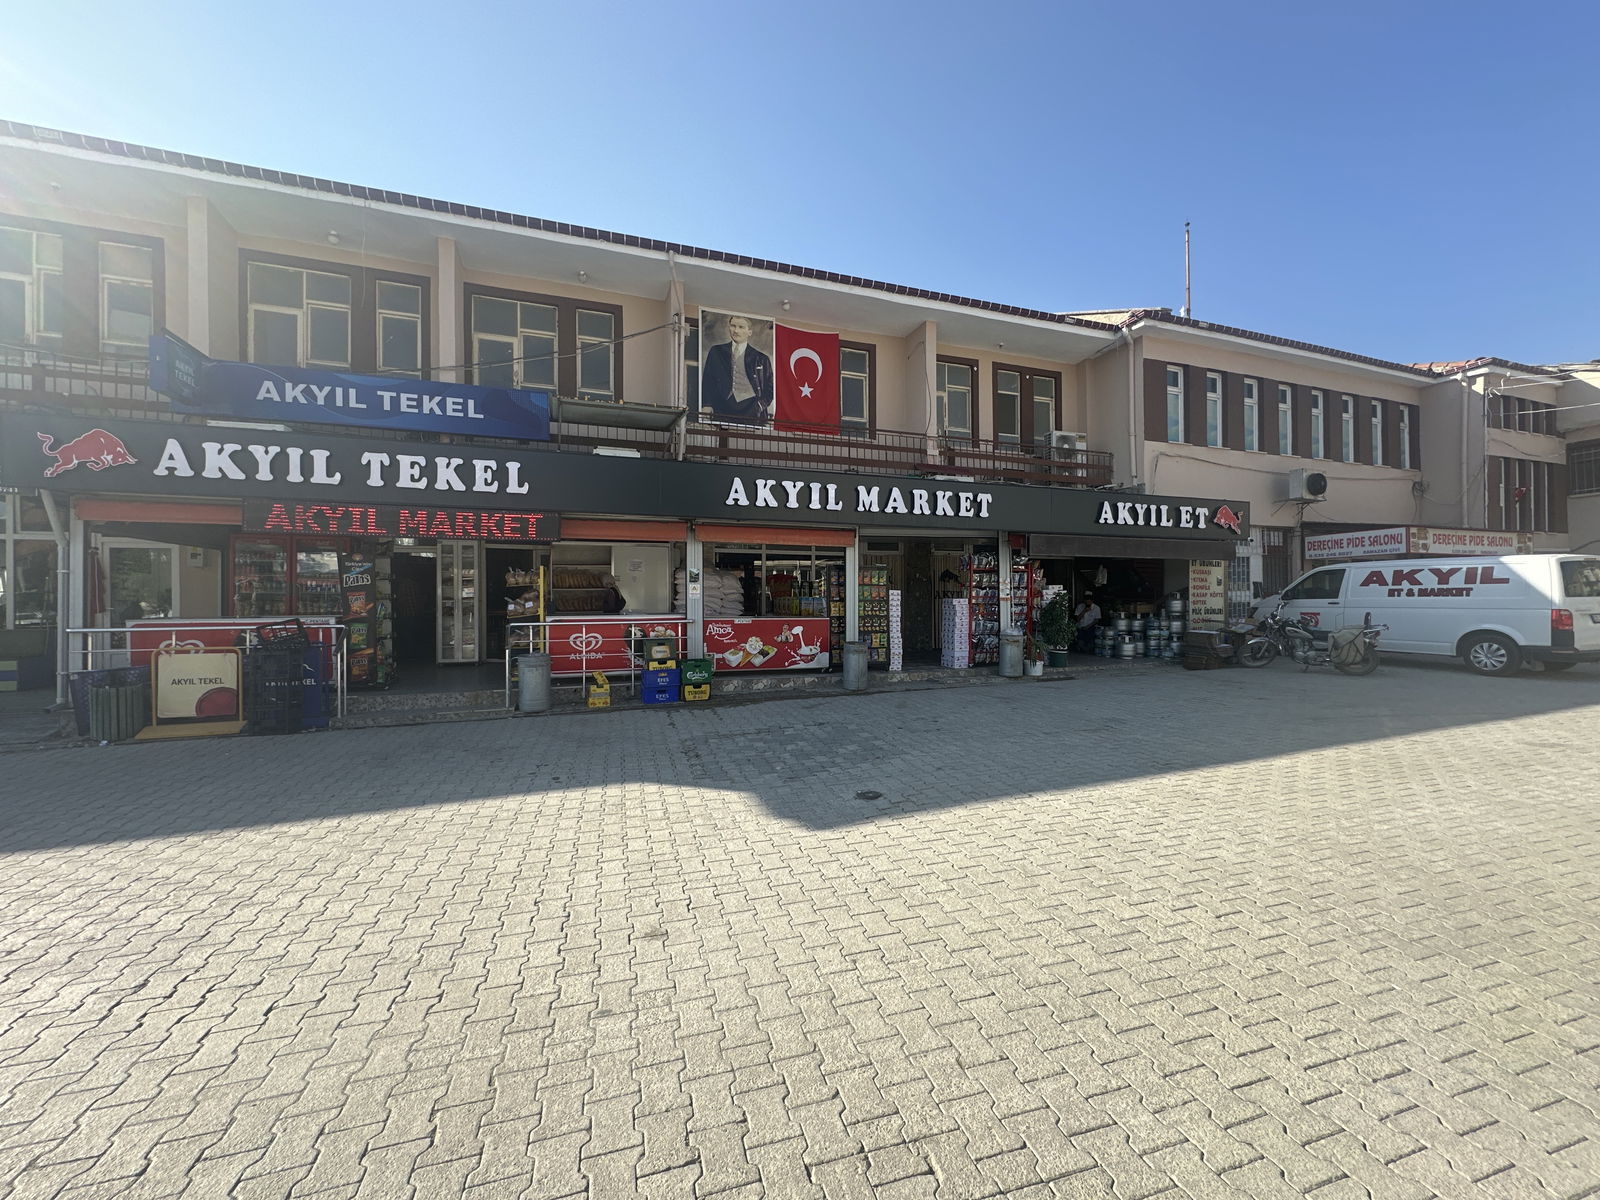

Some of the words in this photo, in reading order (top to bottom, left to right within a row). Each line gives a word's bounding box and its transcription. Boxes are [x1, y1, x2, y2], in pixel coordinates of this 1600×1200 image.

[255, 380, 367, 409] AKYIL
[377, 390, 485, 419] TEKEL
[152, 438, 341, 485] AKYIL
[360, 451, 529, 495] TEKEL
[725, 477, 843, 511] AKYIL
[857, 485, 992, 518] MARKET
[264, 503, 388, 534] AKYIL
[399, 509, 544, 538] MARKET
[1098, 501, 1173, 527] AKYIL
[1179, 506, 1209, 529] ET
[1368, 533, 1403, 547] SALONU
[1487, 536, 1513, 547] SALONU
[1360, 566, 1510, 587] AKYIL
[1387, 588, 1404, 597] ET
[1405, 588, 1415, 597] &
[1417, 587, 1474, 597] MARKET
[171, 677, 196, 686] AKYIL
[197, 677, 225, 685] TEKEL
